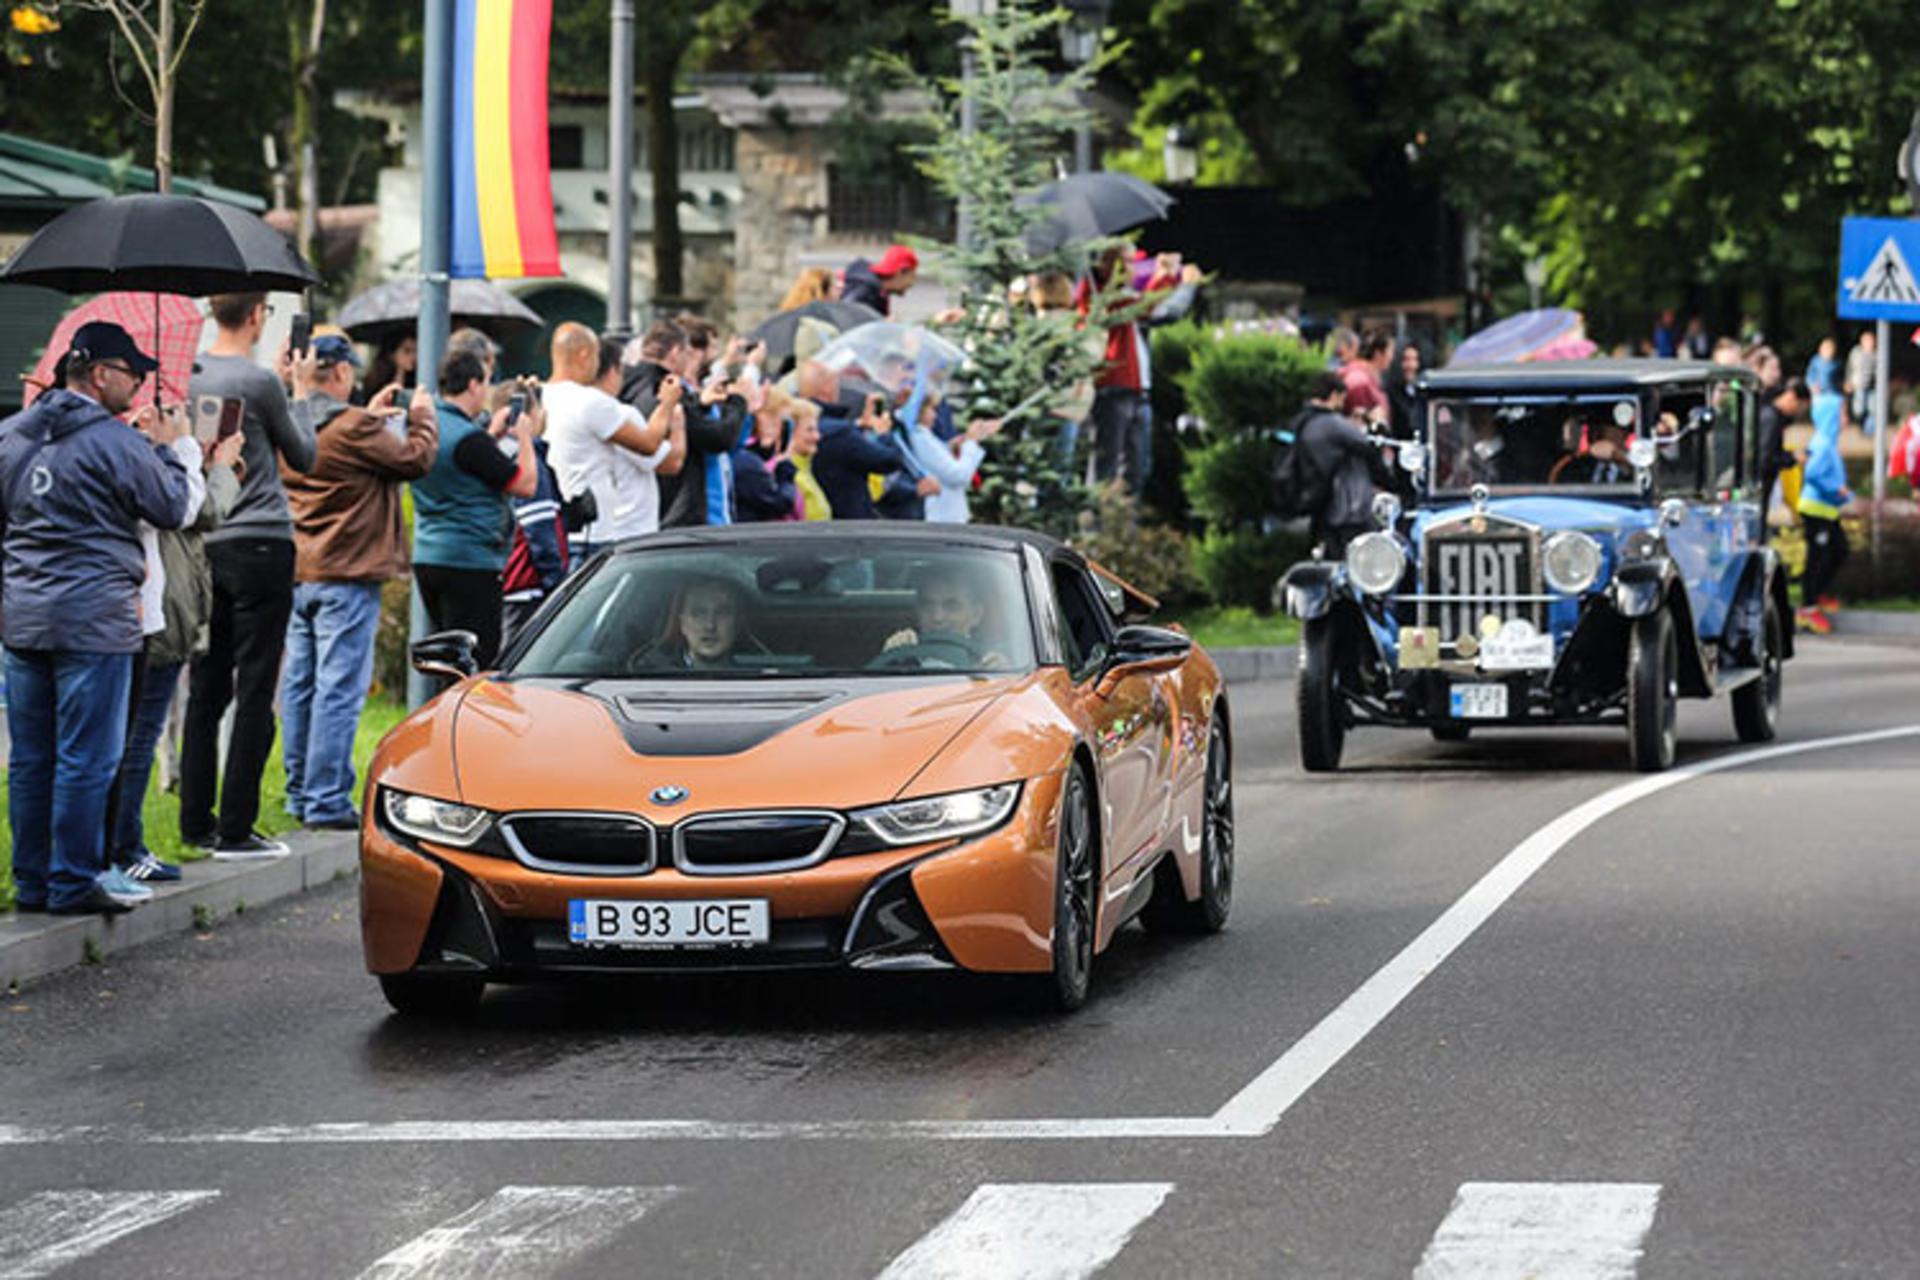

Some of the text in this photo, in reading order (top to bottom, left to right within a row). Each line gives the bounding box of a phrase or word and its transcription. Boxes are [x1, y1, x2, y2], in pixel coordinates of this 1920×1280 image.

[1439, 543, 1523, 642] FIAT
[597, 905, 751, 937] B 93 JCE
